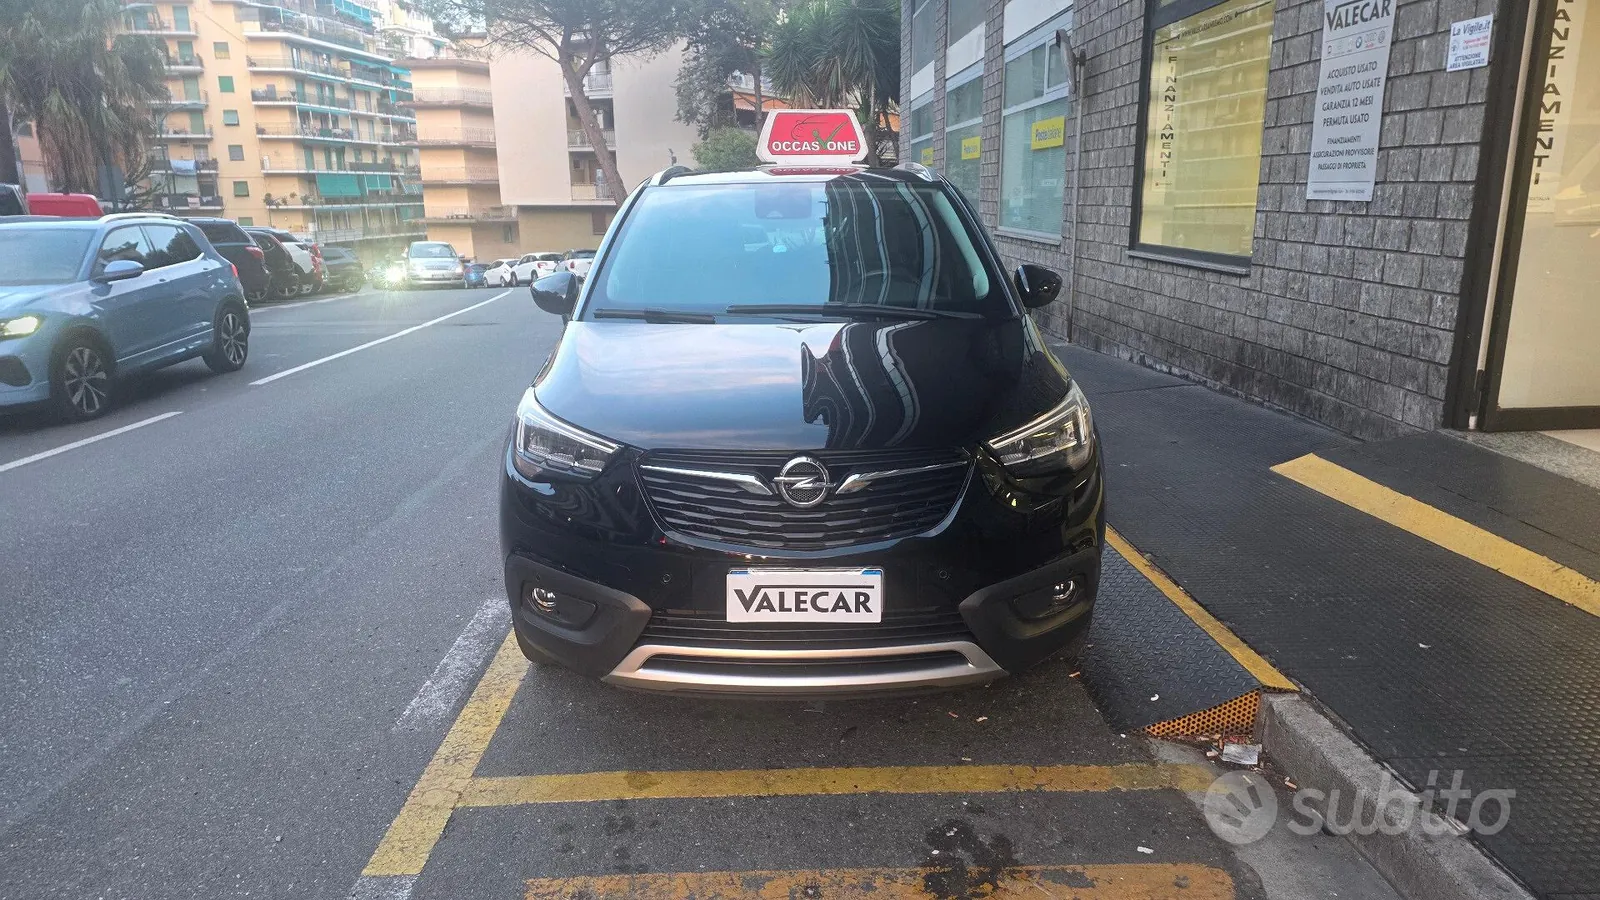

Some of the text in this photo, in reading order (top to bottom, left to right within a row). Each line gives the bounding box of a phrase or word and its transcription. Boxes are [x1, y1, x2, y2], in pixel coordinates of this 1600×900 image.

[1326, 0, 1391, 31] VALECAR
[1452, 20, 1491, 37] La Vigile.it
[1449, 60, 1461, 69] AREA
[1454, 52, 1481, 61] ATTENZIONE
[1327, 61, 1378, 80] ACQUISTO USATO
[1320, 77, 1381, 96] VENDITA AUTO USATE
[1533, 0, 1574, 185] ANZIAMENTI
[1321, 95, 1374, 112] GARANZIA 12 MESI
[1160, 56, 1178, 178] FINANZIAMENTI
[1323, 112, 1370, 127] PERMUTA USATO
[1326, 135, 1362, 145] FINANZIAMENTI
[1312, 147, 1375, 158] ASSICURAZIONI PROVVISORIE
[1317, 162, 1337, 171] PASSAGGI
[1337, 162, 1343, 170] DI
[733, 585, 875, 613] VALECAR
